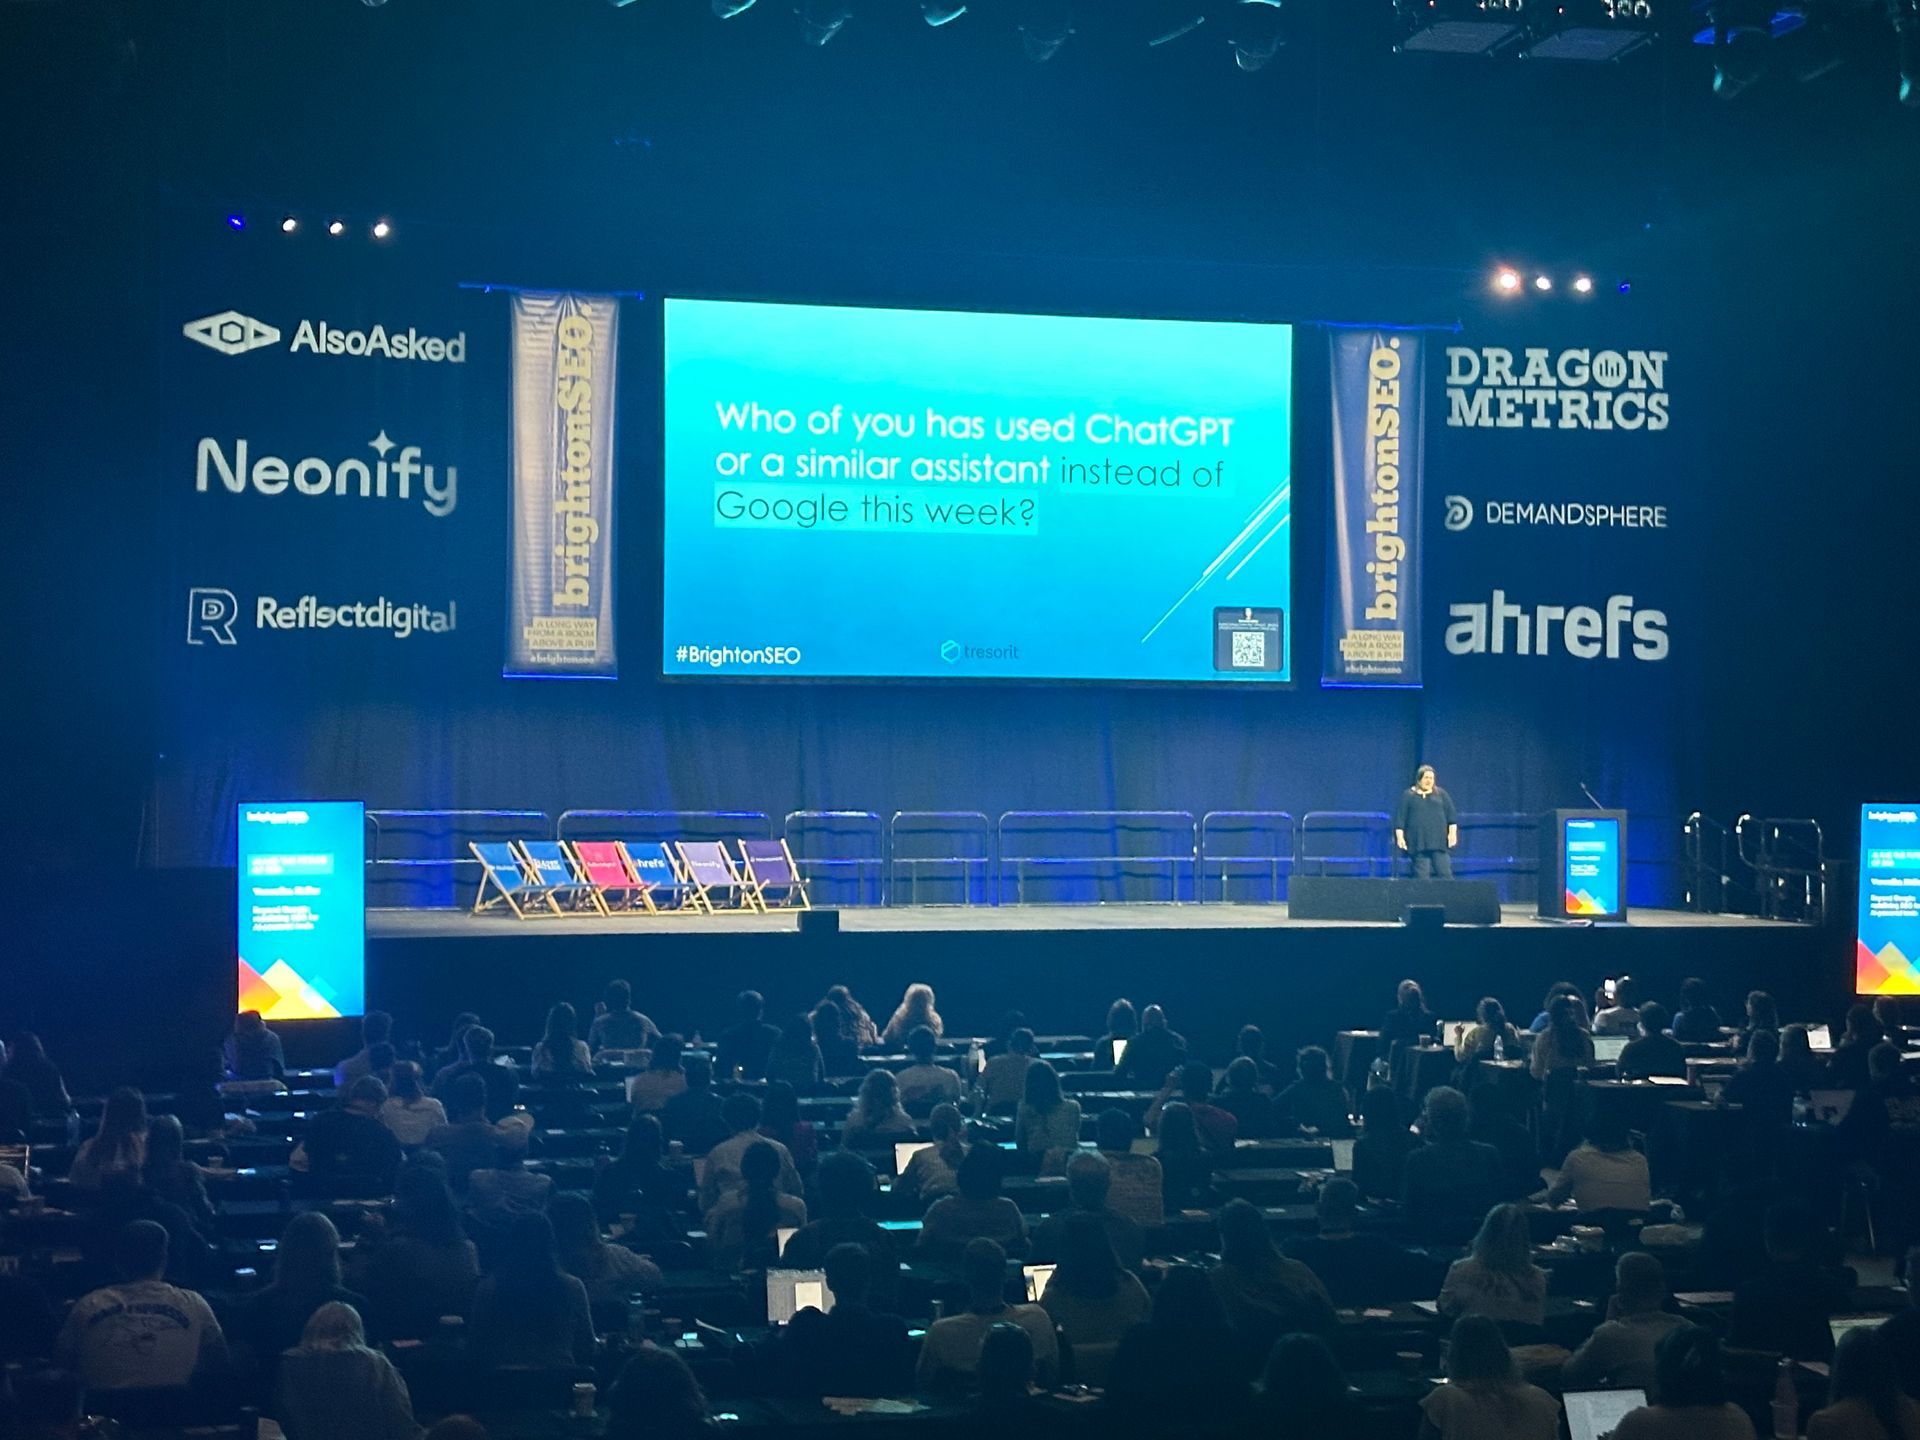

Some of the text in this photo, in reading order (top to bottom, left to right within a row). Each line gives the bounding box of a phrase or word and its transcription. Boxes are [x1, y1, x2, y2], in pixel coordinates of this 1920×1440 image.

[289, 320, 466, 363] AlsoAsked
[1445, 347, 1669, 389] DRAGON
[716, 402, 1233, 447] Who of you has used ChatGPT
[1446, 389, 1669, 431] METRICS
[196, 428, 457, 517] Neonify
[716, 448, 1225, 487] or a similar assistant instead of
[716, 491, 1035, 528] Google this week?
[1486, 501, 1668, 528] DEMANDSPHERE
[1445, 589, 1670, 661] ahrefs
[676, 645, 801, 668] #BrightonSEO
[964, 643, 1019, 660] tresorit
[634, 858, 665, 869] hrefs
